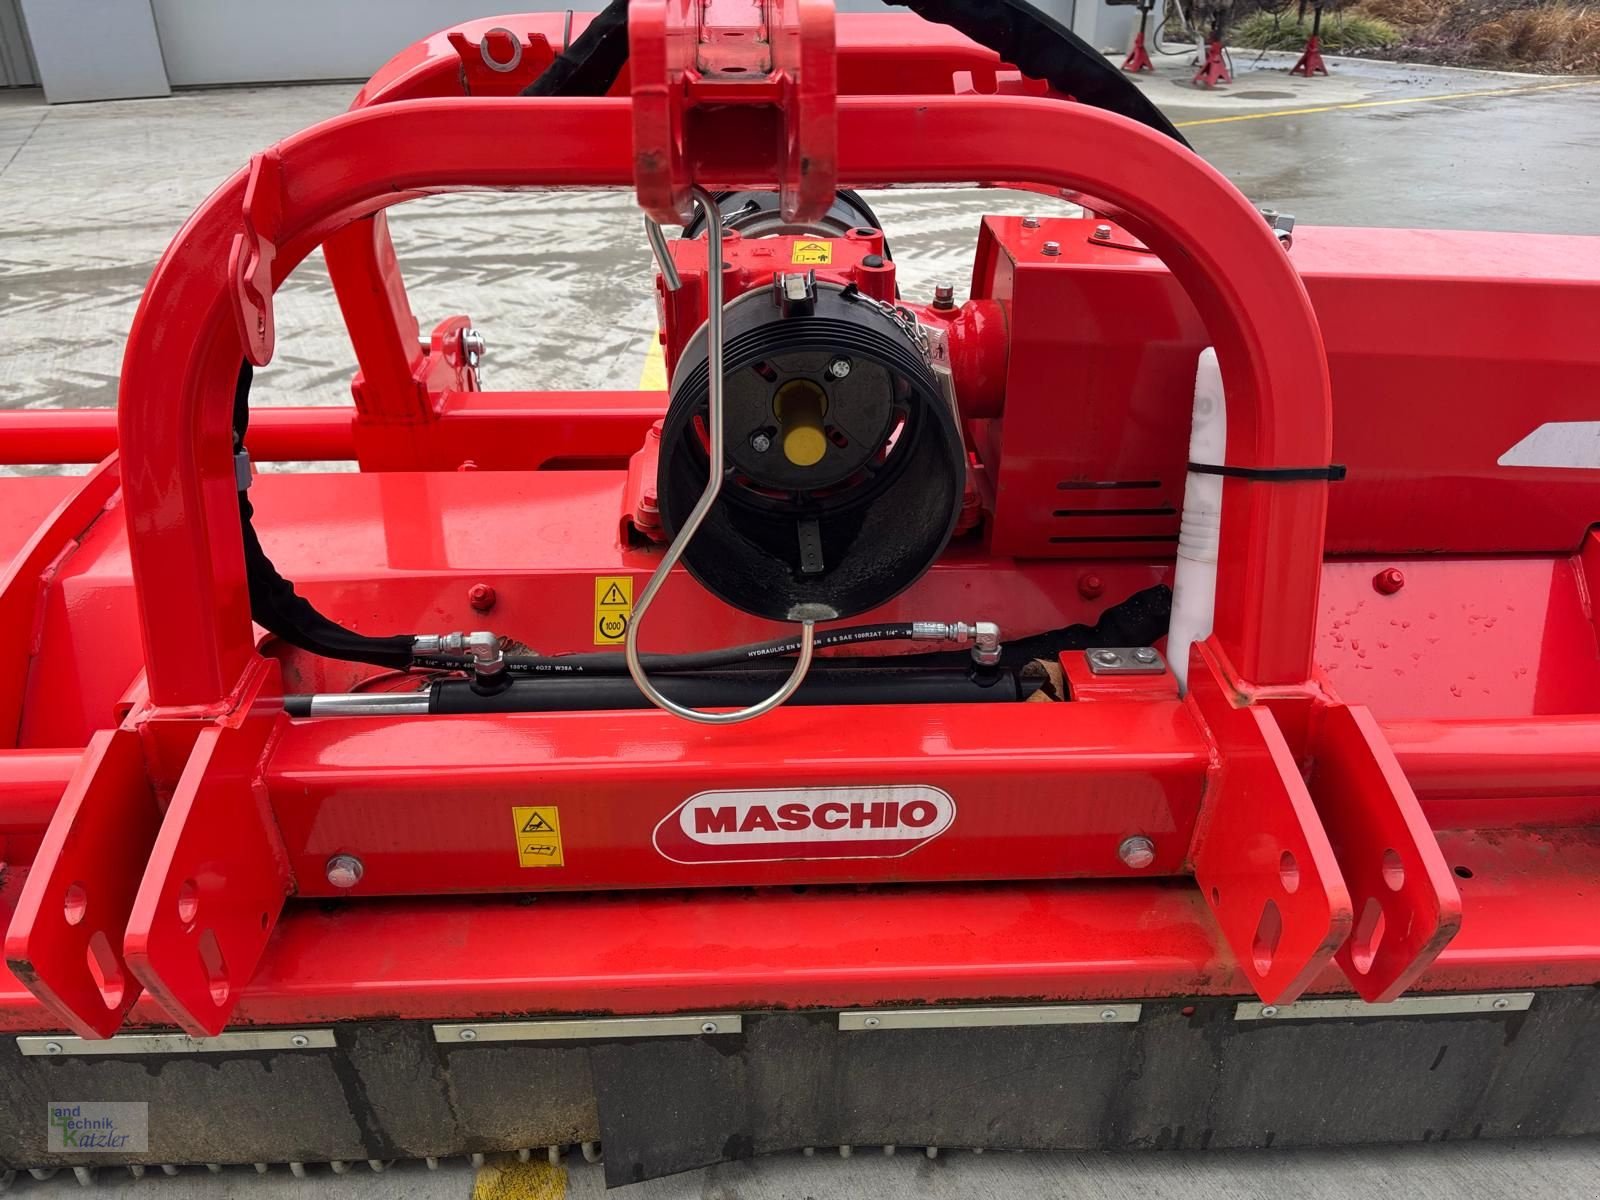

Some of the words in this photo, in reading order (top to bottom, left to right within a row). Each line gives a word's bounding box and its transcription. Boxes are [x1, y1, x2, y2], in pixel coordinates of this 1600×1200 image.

[606, 621, 621, 631] 1000
[748, 645, 785, 657] HYDRAULIC
[786, 643, 796, 651] EN
[839, 633, 853, 641] SAE
[854, 630, 882, 640] 100R2AT
[694, 799, 938, 834] MASCHIO
